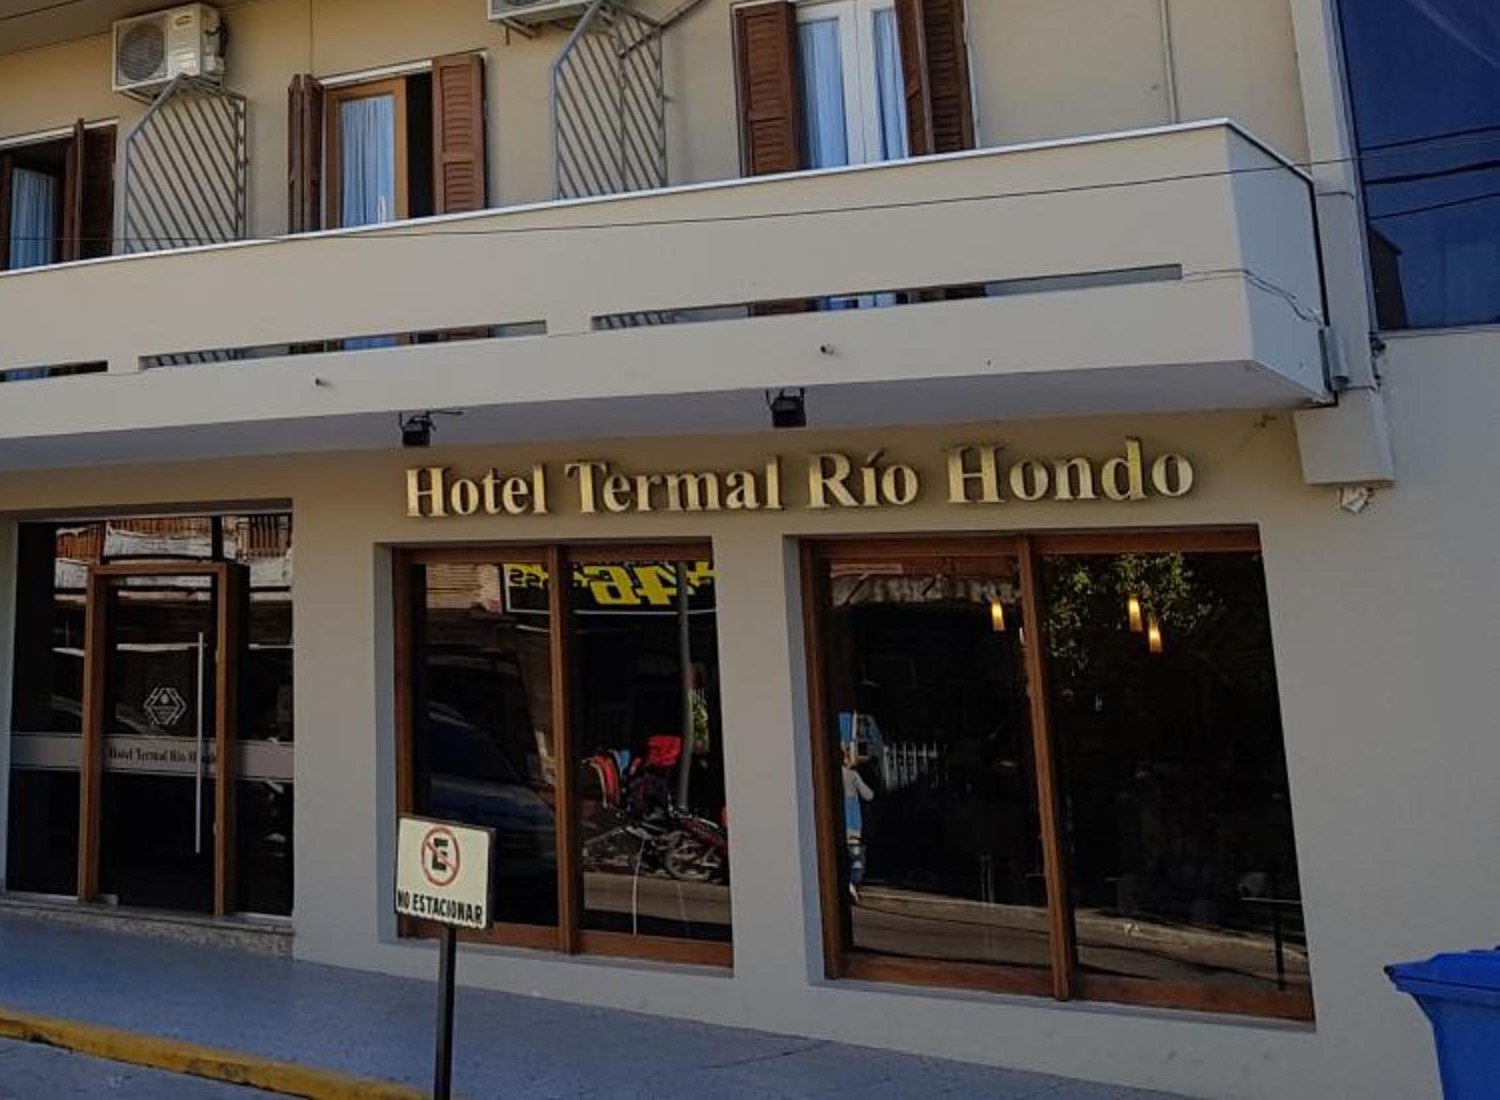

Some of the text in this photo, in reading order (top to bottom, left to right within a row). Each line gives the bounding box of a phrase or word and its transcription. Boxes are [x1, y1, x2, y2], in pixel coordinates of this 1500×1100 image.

[405, 435, 1195, 518] Hotel Termal Río Hondo
[397, 890, 483, 926] NO ESTACIONAR
